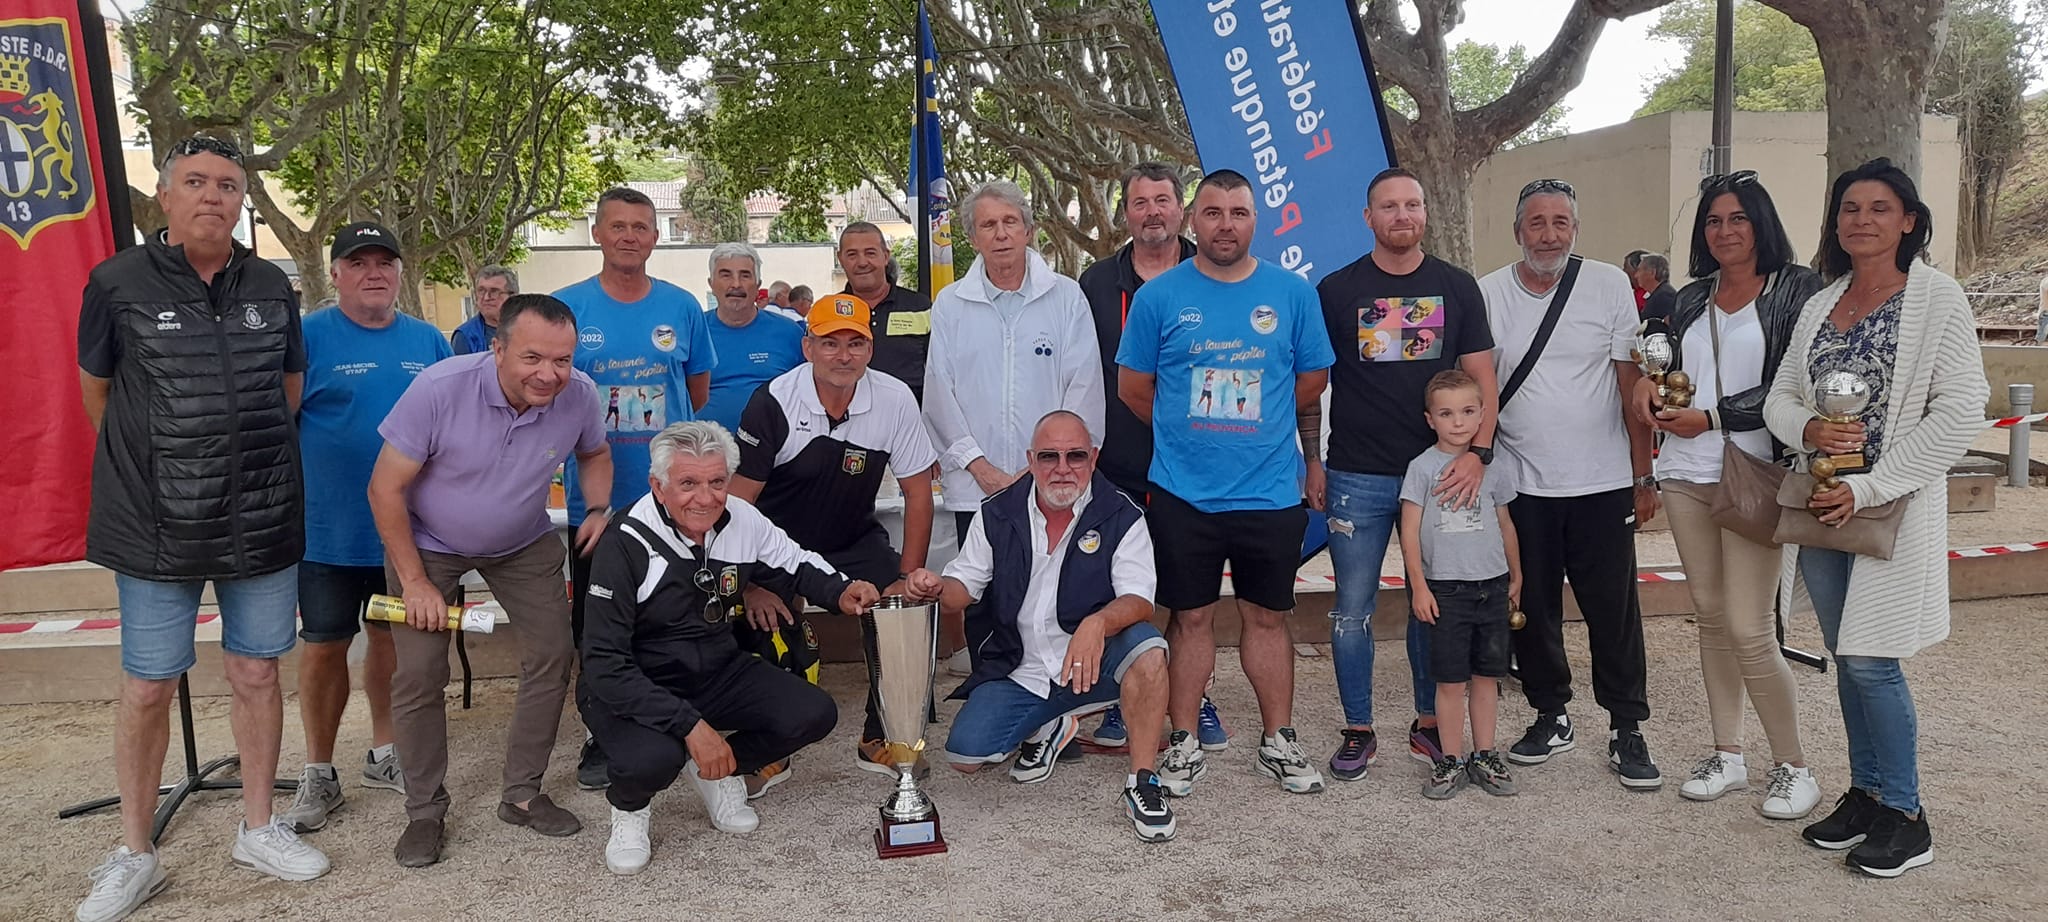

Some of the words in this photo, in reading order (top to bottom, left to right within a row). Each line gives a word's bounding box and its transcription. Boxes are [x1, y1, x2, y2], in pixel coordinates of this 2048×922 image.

[33, 42, 66, 72] B.D.R.
[7, 201, 31, 222] 13
[356, 228, 381, 236] FILA
[1180, 313, 1200, 322] 2022
[581, 334, 602, 342] 2022
[1189, 338, 1202, 354] La
